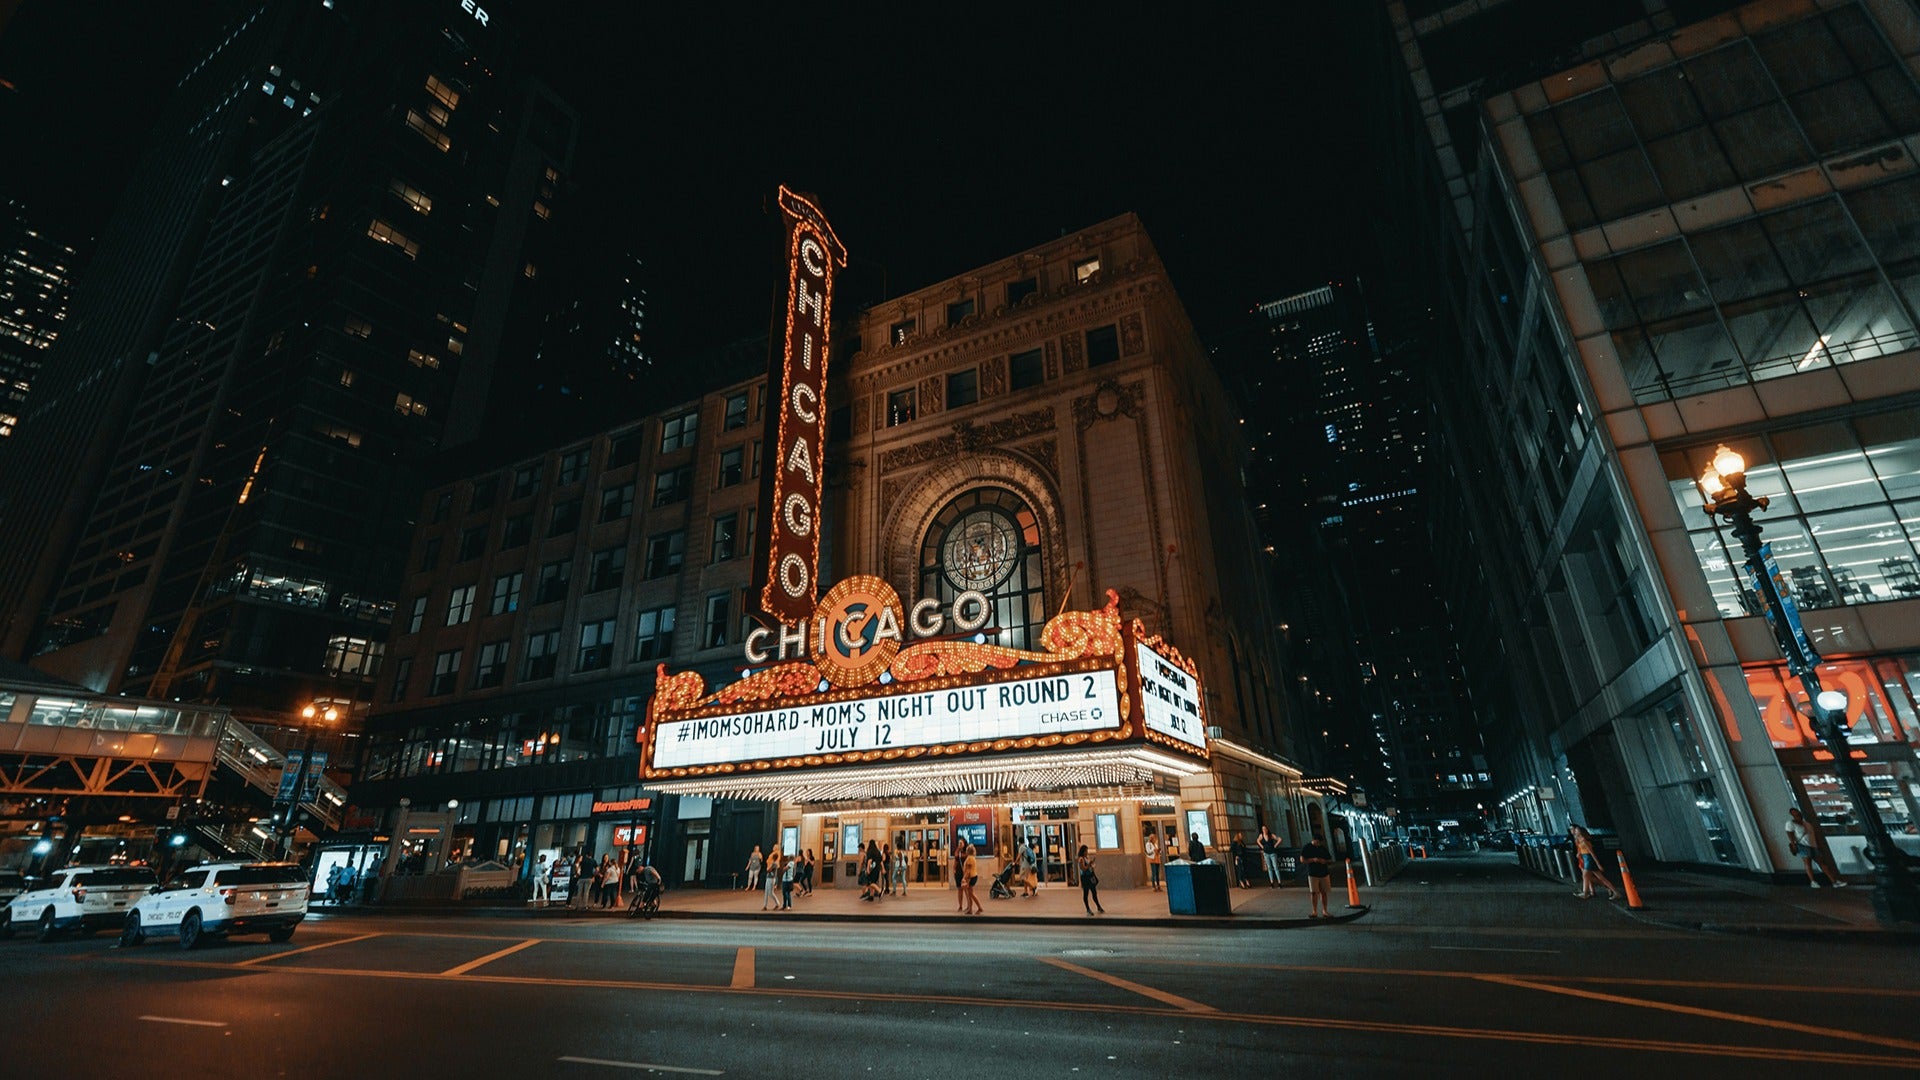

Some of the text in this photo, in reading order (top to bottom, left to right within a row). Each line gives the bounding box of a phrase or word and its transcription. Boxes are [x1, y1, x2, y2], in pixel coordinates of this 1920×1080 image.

[461, 0, 489, 27] ER
[780, 238, 824, 599] CHICAGO
[745, 590, 991, 664] CHICAGO
[878, 694, 934, 721] NIGHT
[947, 688, 987, 713] OUT
[999, 678, 1070, 708] ROUND
[1082, 675, 1097, 699] 2
[1041, 709, 1088, 725] CHASE
[815, 724, 892, 751] JULY 12
